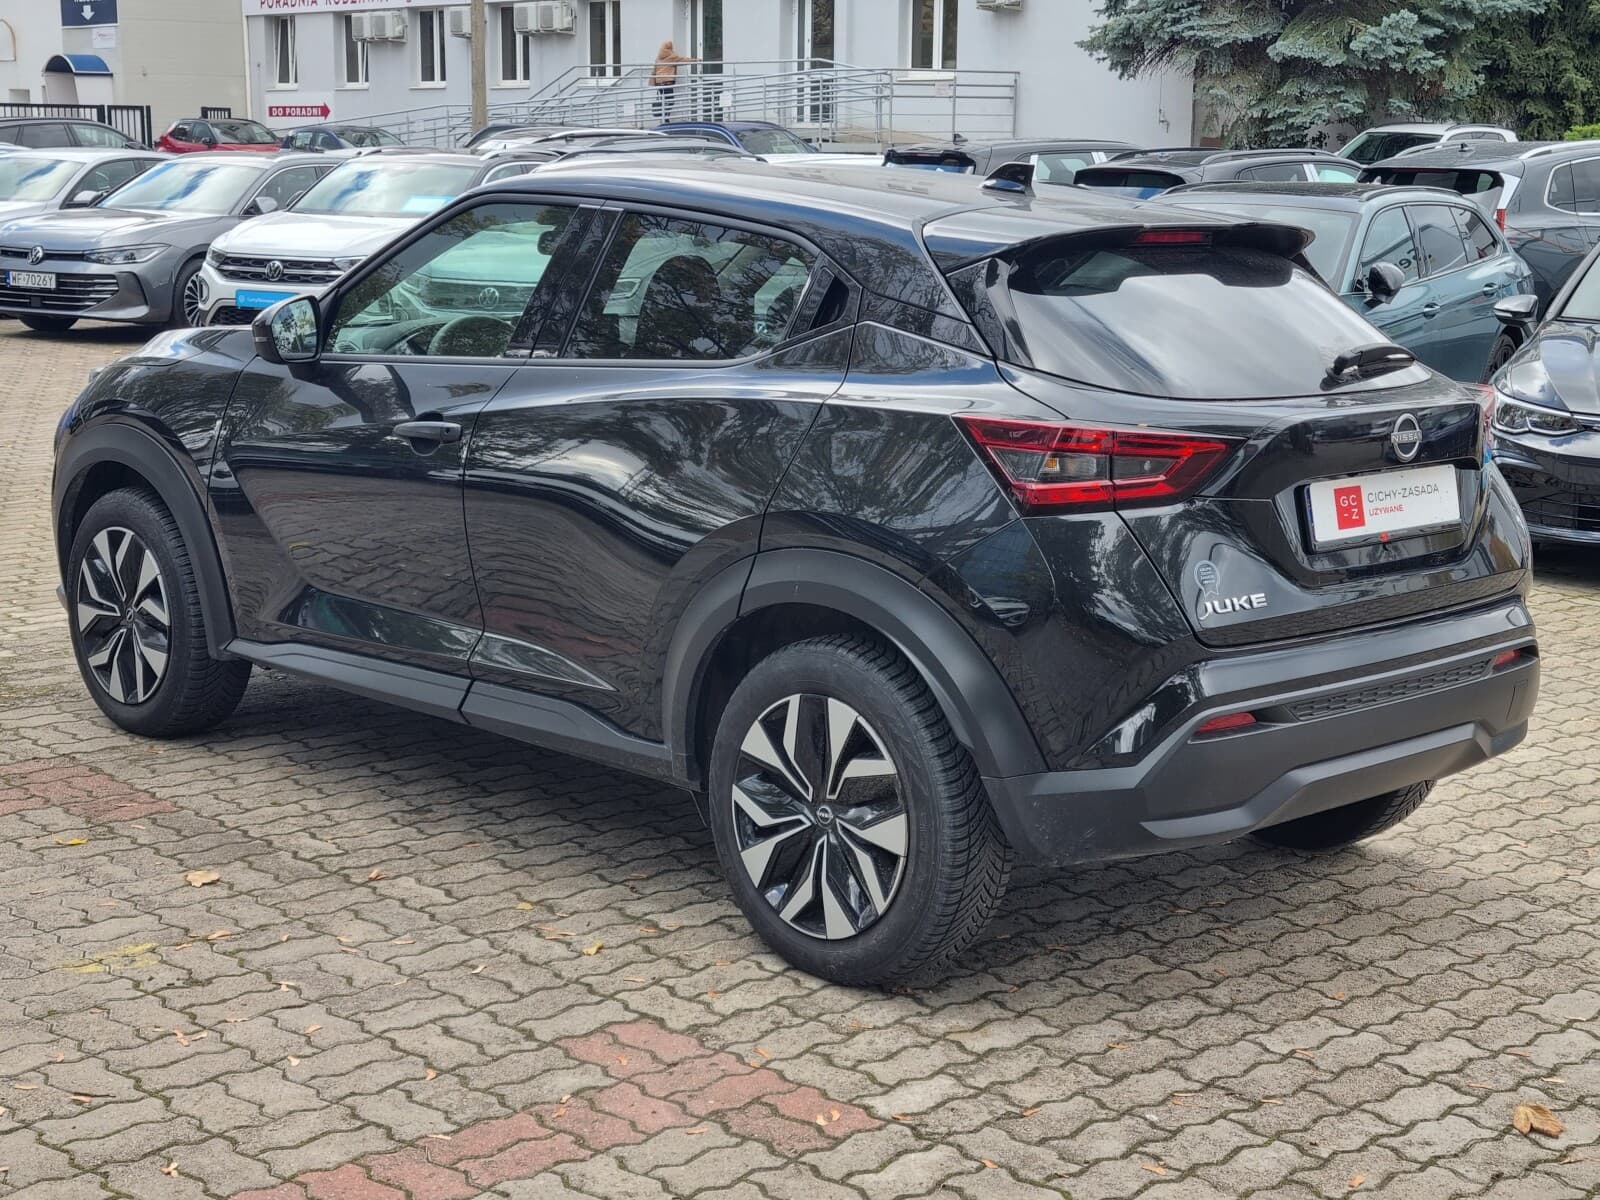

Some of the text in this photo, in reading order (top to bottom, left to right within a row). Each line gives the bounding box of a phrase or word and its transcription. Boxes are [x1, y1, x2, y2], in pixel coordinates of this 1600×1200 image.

[272, 107, 321, 116] DO PORADNI
[1340, 494, 1358, 507] GC
[1367, 483, 1440, 503] CICHY-ZASADA
[1199, 592, 1268, 620] JUKE
